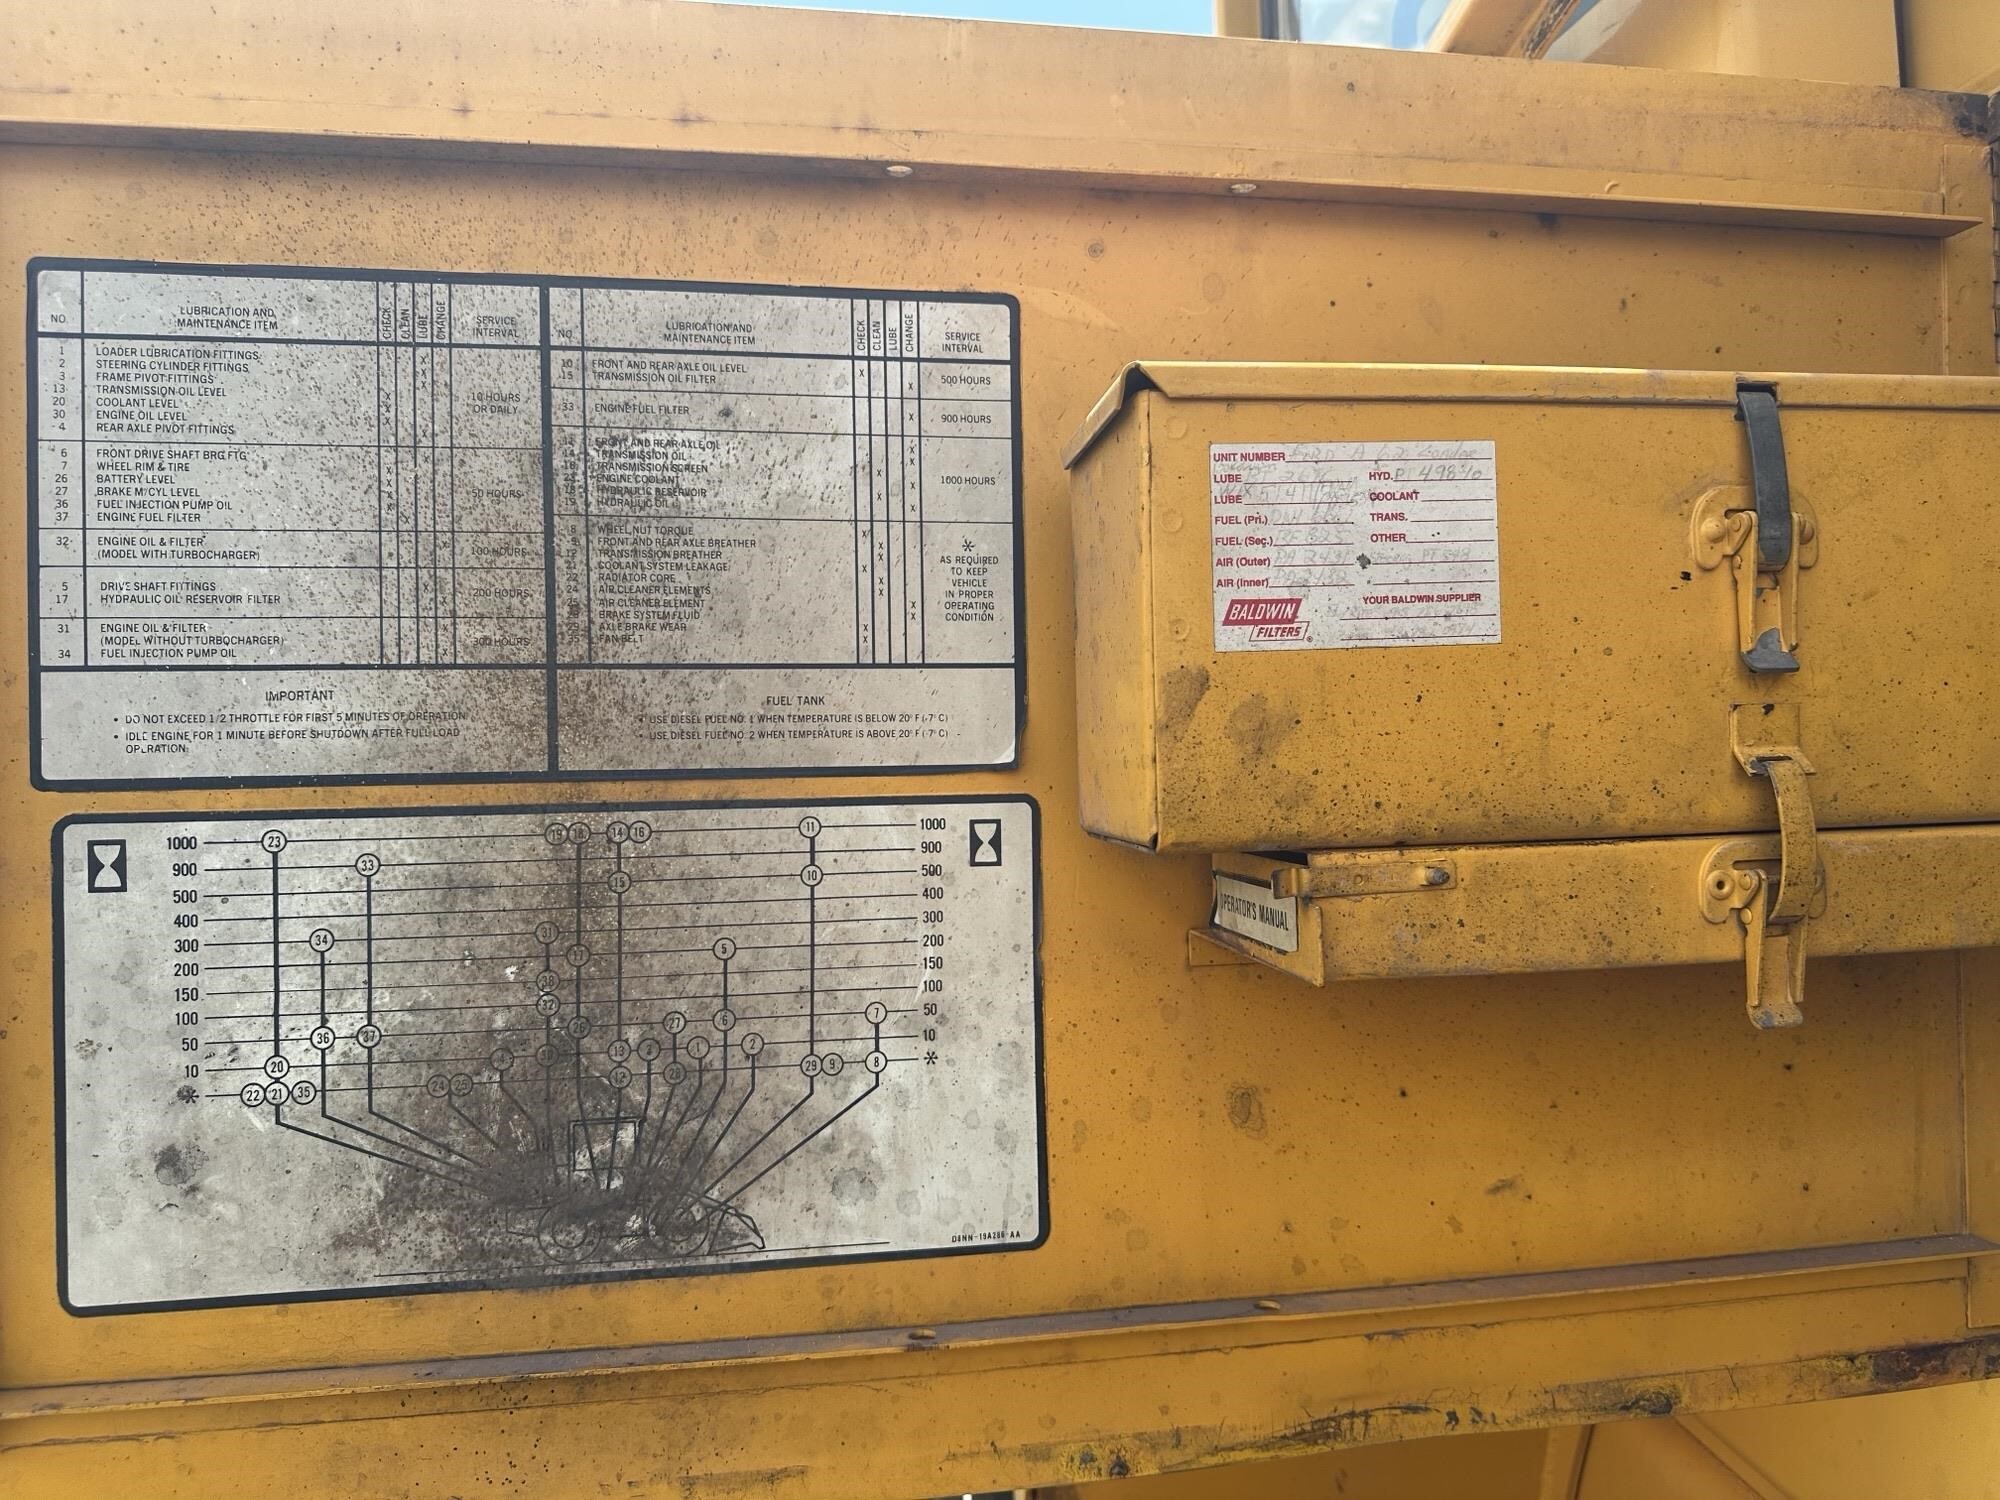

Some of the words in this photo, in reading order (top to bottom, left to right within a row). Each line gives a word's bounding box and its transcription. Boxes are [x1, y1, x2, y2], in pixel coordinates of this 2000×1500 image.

[180, 307, 250, 316] LUBRICATION
[177, 318, 251, 329] MAINTENANCE
[254, 321, 278, 330] ITEM
[383, 308, 391, 338] CHECK
[436, 301, 445, 339] CHANGE
[476, 316, 516, 325] SERVICE
[418, 315, 427, 338] LUBE
[666, 321, 729, 331] LUBRICATION
[732, 324, 752, 332] AND
[473, 329, 519, 337] INTERVAL
[857, 320, 866, 350] CHECK
[873, 321, 881, 350] CLEAN
[906, 314, 914, 351] CHANGE
[945, 332, 981, 341] SERVICE
[664, 334, 732, 344] MAINTENANCE
[734, 336, 755, 344] ITEM
[889, 327, 897, 350] LUBE
[96, 348, 137, 356] LOADER
[140, 349, 210, 358] LUBRICATION
[213, 350, 259, 359] FITTINGS
[942, 344, 984, 353] INTERVAL
[96, 360, 146, 370] STEERING
[149, 361, 200, 370] CYLINDER
[203, 363, 249, 372] FITTINGS
[592, 359, 624, 368] FRONT
[627, 360, 646, 369] AND
[650, 362, 674, 370] REAR
[677, 362, 699, 371] AXLE
[702, 363, 717, 372] OIL
[720, 364, 747, 372] LEVEL
[96, 373, 132, 381] FRAME
[135, 373, 166, 382] PIVOT
[168, 375, 214, 383] FITTINGS
[593, 372, 665, 382] TRANSMISSION
[668, 374, 682, 383] OIL
[686, 375, 716, 383] FILTER
[941, 376, 957, 384] 500
[960, 376, 991, 385] HOURS
[97, 385, 175, 395] TRANSMISSION
[178, 388, 195, 396] OIL
[199, 388, 227, 397] LEVEL
[96, 398, 145, 407] COOLANT
[149, 399, 178, 408] LEVEL
[97, 410, 135, 420] ENGINE
[138, 411, 154, 420] OIL
[158, 412, 187, 421] LEVEL
[941, 415, 957, 423] 900
[960, 415, 991, 423] HOURS
[97, 423, 123, 432] REAR
[127, 423, 152, 433] AXLE
[155, 424, 185, 433] PIVOT
[188, 424, 234, 435] FITTINGS
[97, 449, 131, 458] FRONT
[134, 450, 164, 459] DRIVE
[167, 450, 200, 459] SHAFT
[1214, 453, 1237, 461] UNIT
[1240, 452, 1285, 461] NUMBER
[97, 462, 131, 471] WHEEL
[135, 462, 154, 471] RIM
[158, 463, 166, 471] &
[168, 463, 190, 471] TIRE
[941, 476, 962, 484] 1000
[964, 476, 995, 485] HOURS
[1214, 474, 1242, 483] LUBE
[1369, 472, 1393, 480] HYD.
[1215, 495, 1242, 504] LUBE
[1370, 492, 1419, 501] COOLANT
[97, 500, 122, 509] FUEL
[126, 500, 180, 509] INJECTION
[183, 500, 213, 510] PUMP
[216, 501, 232, 510] OIL
[97, 513, 136, 521] ENGINE
[139, 513, 164, 522] FUEL
[167, 513, 200, 522] FILTER
[1215, 516, 1242, 524] FUEL
[1245, 515, 1268, 525] (Pri.)
[1370, 513, 1408, 521] TRANS.
[1216, 537, 1243, 546] FUEL
[1245, 536, 1273, 546] (Sec.)
[1371, 534, 1406, 542] OTHER
[97, 549, 138, 559] (MODEL
[141, 550, 167, 559] WITH
[171, 550, 260, 560] TURBOCHARGER)
[940, 556, 951, 564] AS
[955, 556, 998, 564] REQUIRED
[1216, 558, 1234, 567] AIR
[1236, 557, 1270, 568] (Outer)
[599, 574, 647, 582] RADIATOR
[650, 574, 675, 583] CORE
[952, 579, 987, 587] VEHICLE
[1216, 579, 1233, 587] AIR
[1236, 578, 1269, 588] (Inner)
[100, 595, 161, 603] HYDRAULIC
[164, 595, 180, 603] OIL
[186, 595, 242, 603] RESERVOIR
[247, 595, 280, 603] FILTER
[1363, 596, 1388, 604] YOUR
[1391, 595, 1435, 603] BALDWIN
[1436, 593, 1481, 602] SUPPLIER
[944, 602, 994, 610] OPERATING
[1229, 603, 1296, 619] BALDWIN
[945, 613, 994, 621] CONDITION
[1257, 627, 1301, 637] FILTERS
[265, 691, 334, 701] IMPORTANT
[767, 696, 792, 705] FUEL
[798, 696, 825, 705] TANK
[806, 822, 815, 832] 11
[920, 818, 946, 830] 1000
[167, 837, 197, 850] 1000
[268, 836, 280, 848] 23
[921, 842, 942, 853] 900
[172, 863, 197, 876] 900
[361, 860, 374, 871] 33
[922, 865, 942, 877] 500
[808, 870, 817, 881] 10
[173, 890, 197, 903] 500
[923, 888, 943, 899] 400
[923, 911, 943, 923] 300
[1220, 894, 1257, 920] OPERATOR'S
[1259, 904, 1289, 931] MANUAL
[174, 914, 198, 928] 400
[174, 939, 198, 952] 300
[315, 934, 328, 946] 34
[923, 935, 944, 946] 200
[722, 944, 727, 954] 5
[924, 957, 943, 969] 150
[174, 964, 198, 977] 200
[924, 980, 942, 992] 100
[175, 988, 198, 1001] 150
[874, 1008, 879, 1018] 7
[924, 1004, 937, 1016] 50
[175, 1012, 198, 1025] 100
[317, 1033, 329, 1044] 36
[924, 1030, 935, 1041] 10
[182, 1038, 198, 1050] 50
[271, 1061, 283, 1073] 20
[806, 1061, 817, 1071] 29
[874, 1056, 879, 1067] 8
[185, 1065, 198, 1077] 10
[247, 1090, 260, 1102] 22
[297, 1086, 310, 1098] 35
